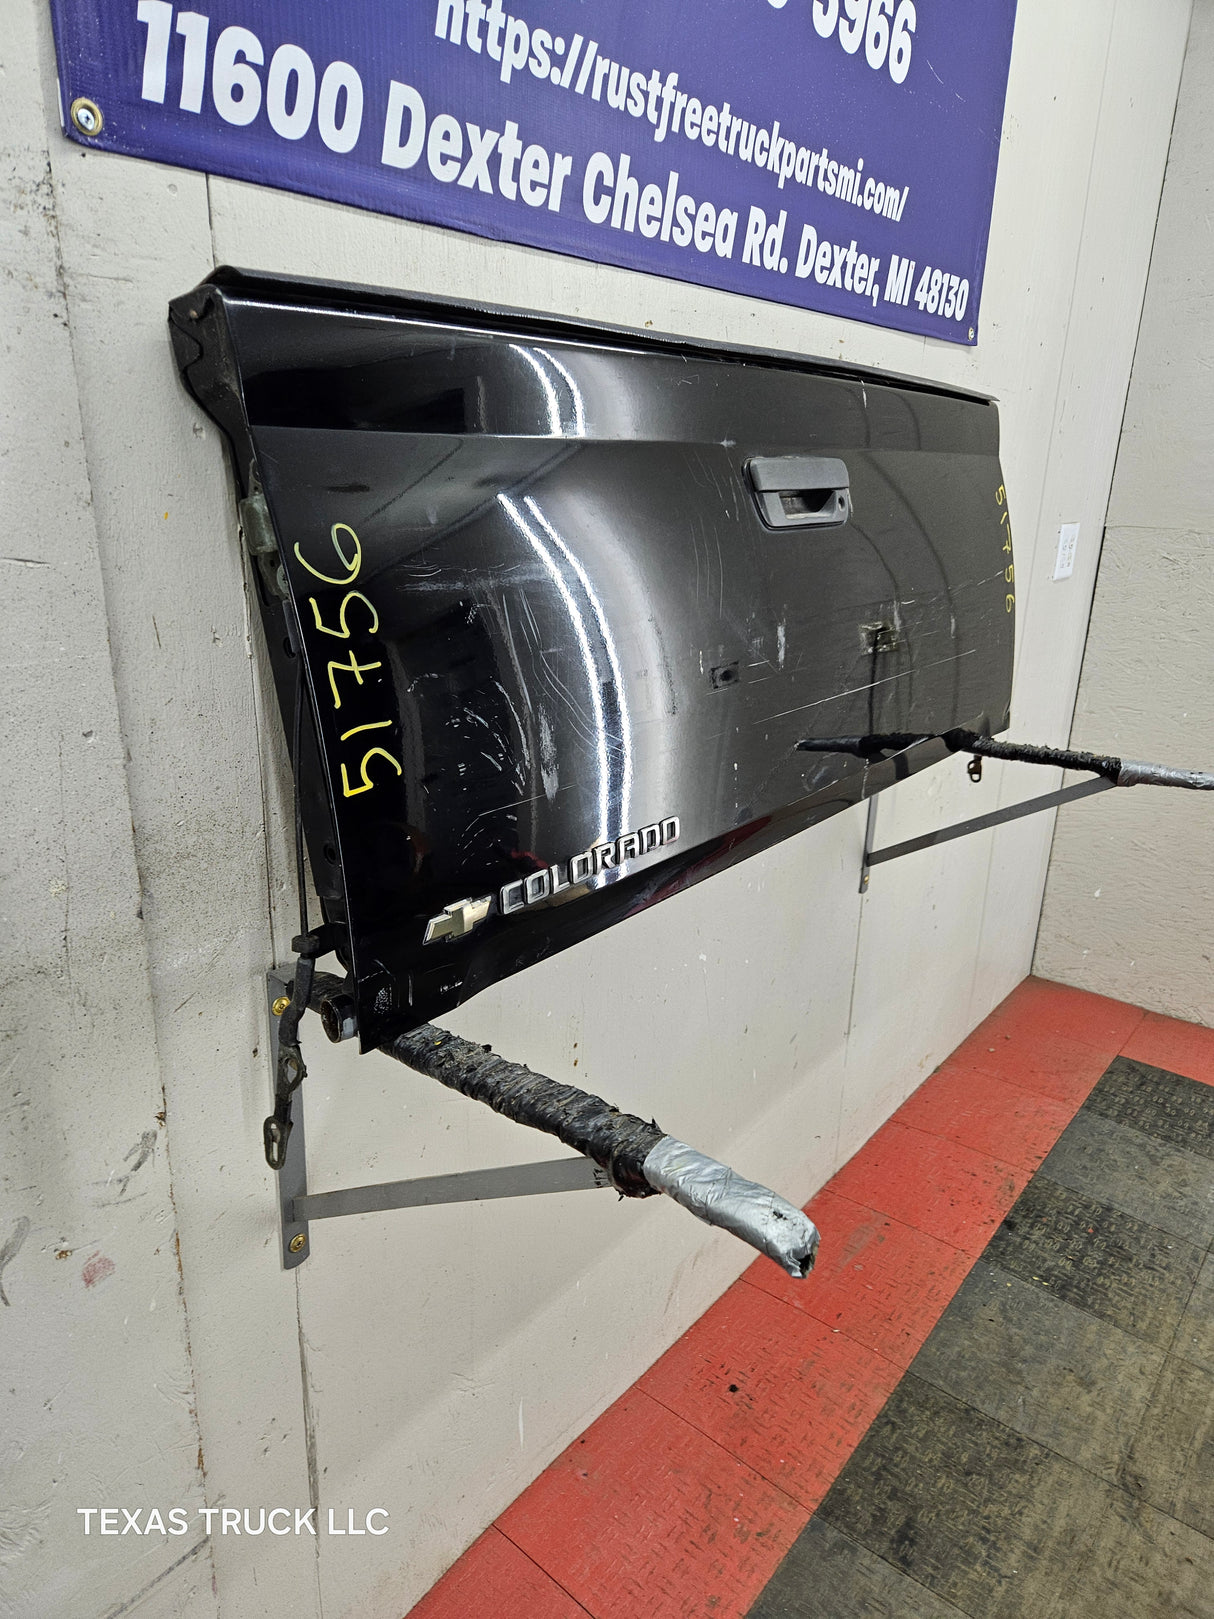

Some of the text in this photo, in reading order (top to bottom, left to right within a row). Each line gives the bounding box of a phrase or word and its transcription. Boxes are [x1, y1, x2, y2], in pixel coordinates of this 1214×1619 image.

[136, 0, 970, 322] 11600 Dexter Chelsea Rd. Dexter, MI 48130
[434, 0, 910, 222] https://rustfreetruckpartsmi.com/
[996, 484, 1016, 613] 51756
[293, 523, 403, 798] 51756
[498, 815, 682, 915] COLORADO
